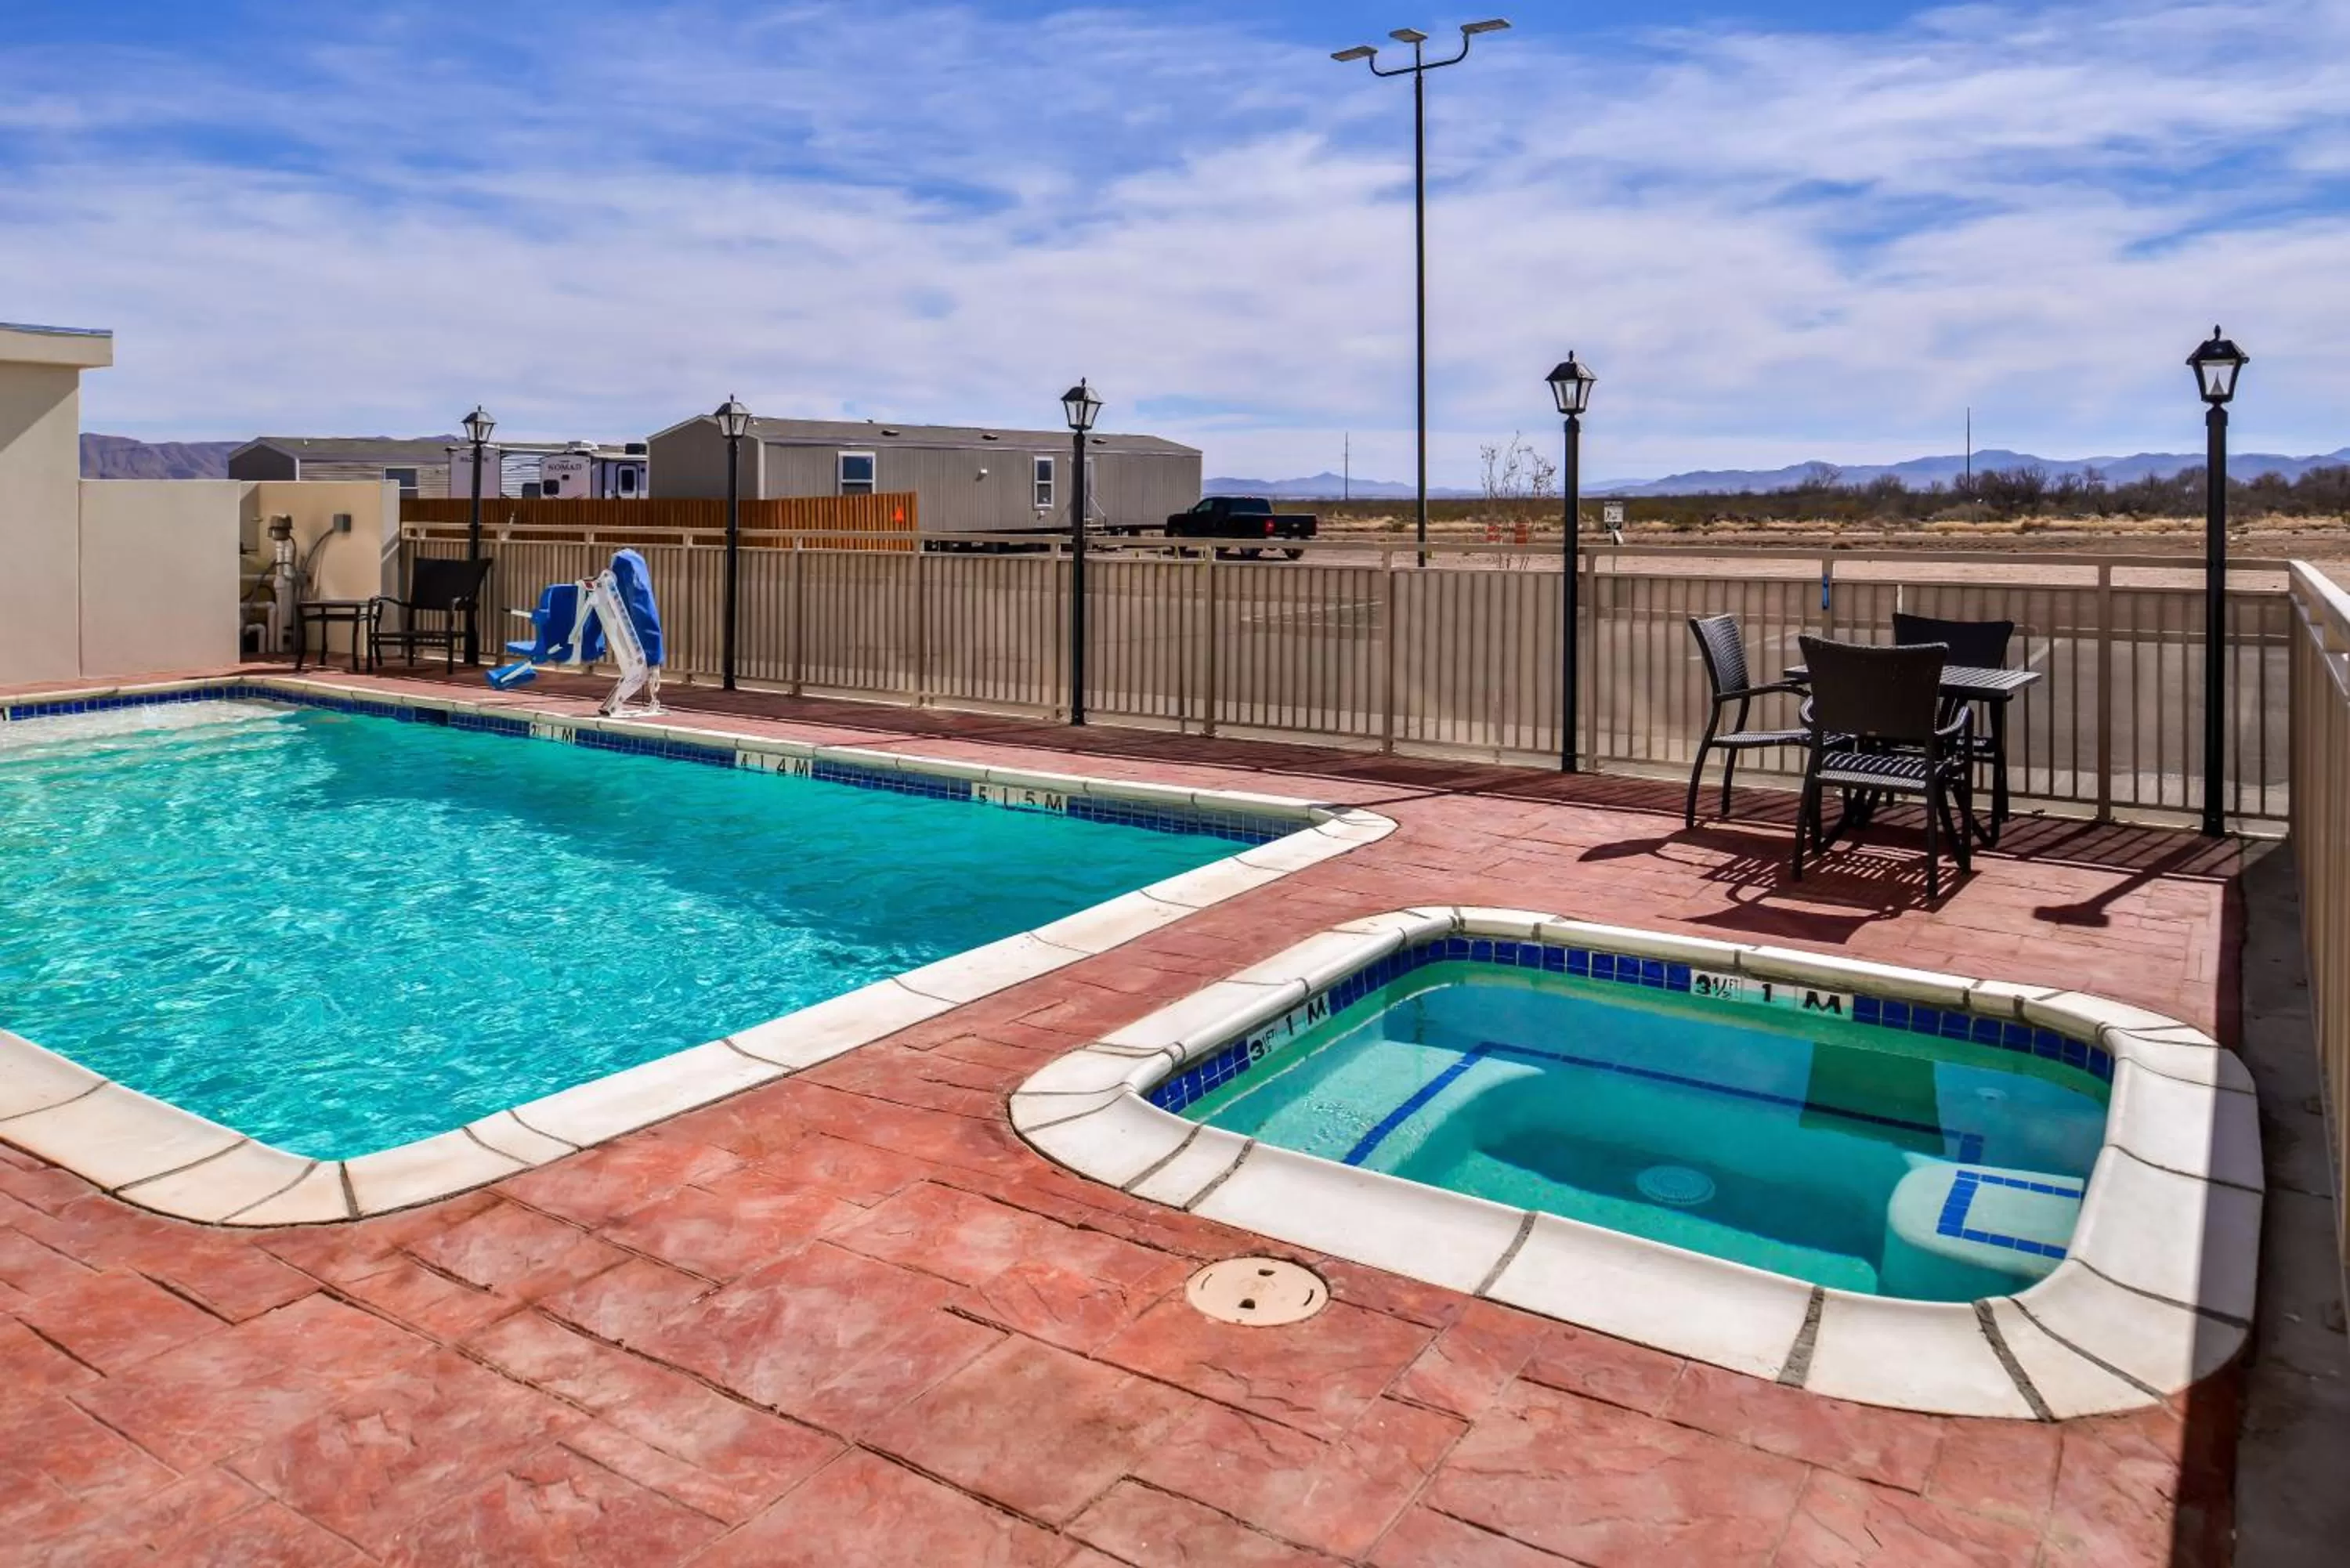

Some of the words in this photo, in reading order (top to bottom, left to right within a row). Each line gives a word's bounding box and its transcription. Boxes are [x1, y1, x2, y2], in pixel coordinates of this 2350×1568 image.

[562, 728, 573, 743] M
[777, 758, 786, 772] 4
[794, 759, 808, 777] M
[1025, 790, 1036, 805] 5
[1045, 793, 1062, 811] M
[1762, 983, 1772, 1002] 1
[1802, 991, 1842, 1015] M
[1285, 1015, 1292, 1035] 1
[1307, 996, 1326, 1025] M
